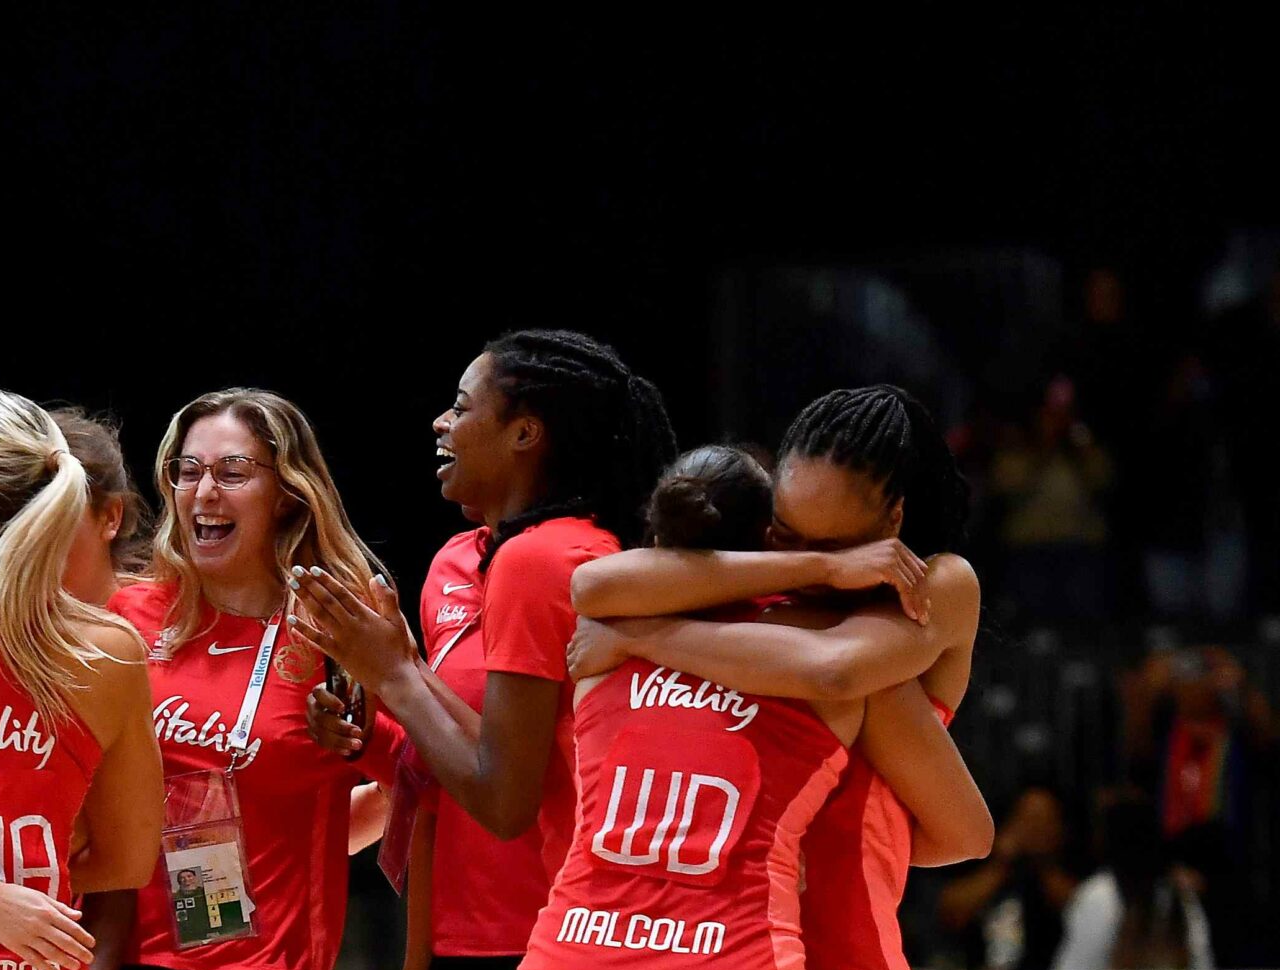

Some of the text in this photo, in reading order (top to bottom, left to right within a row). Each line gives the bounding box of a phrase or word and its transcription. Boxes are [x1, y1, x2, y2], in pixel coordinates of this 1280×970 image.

[250, 645, 272, 688] Telkom
[630, 667, 760, 732] Vitality
[591, 766, 741, 875] WD
[557, 907, 726, 954] MALCOLM
